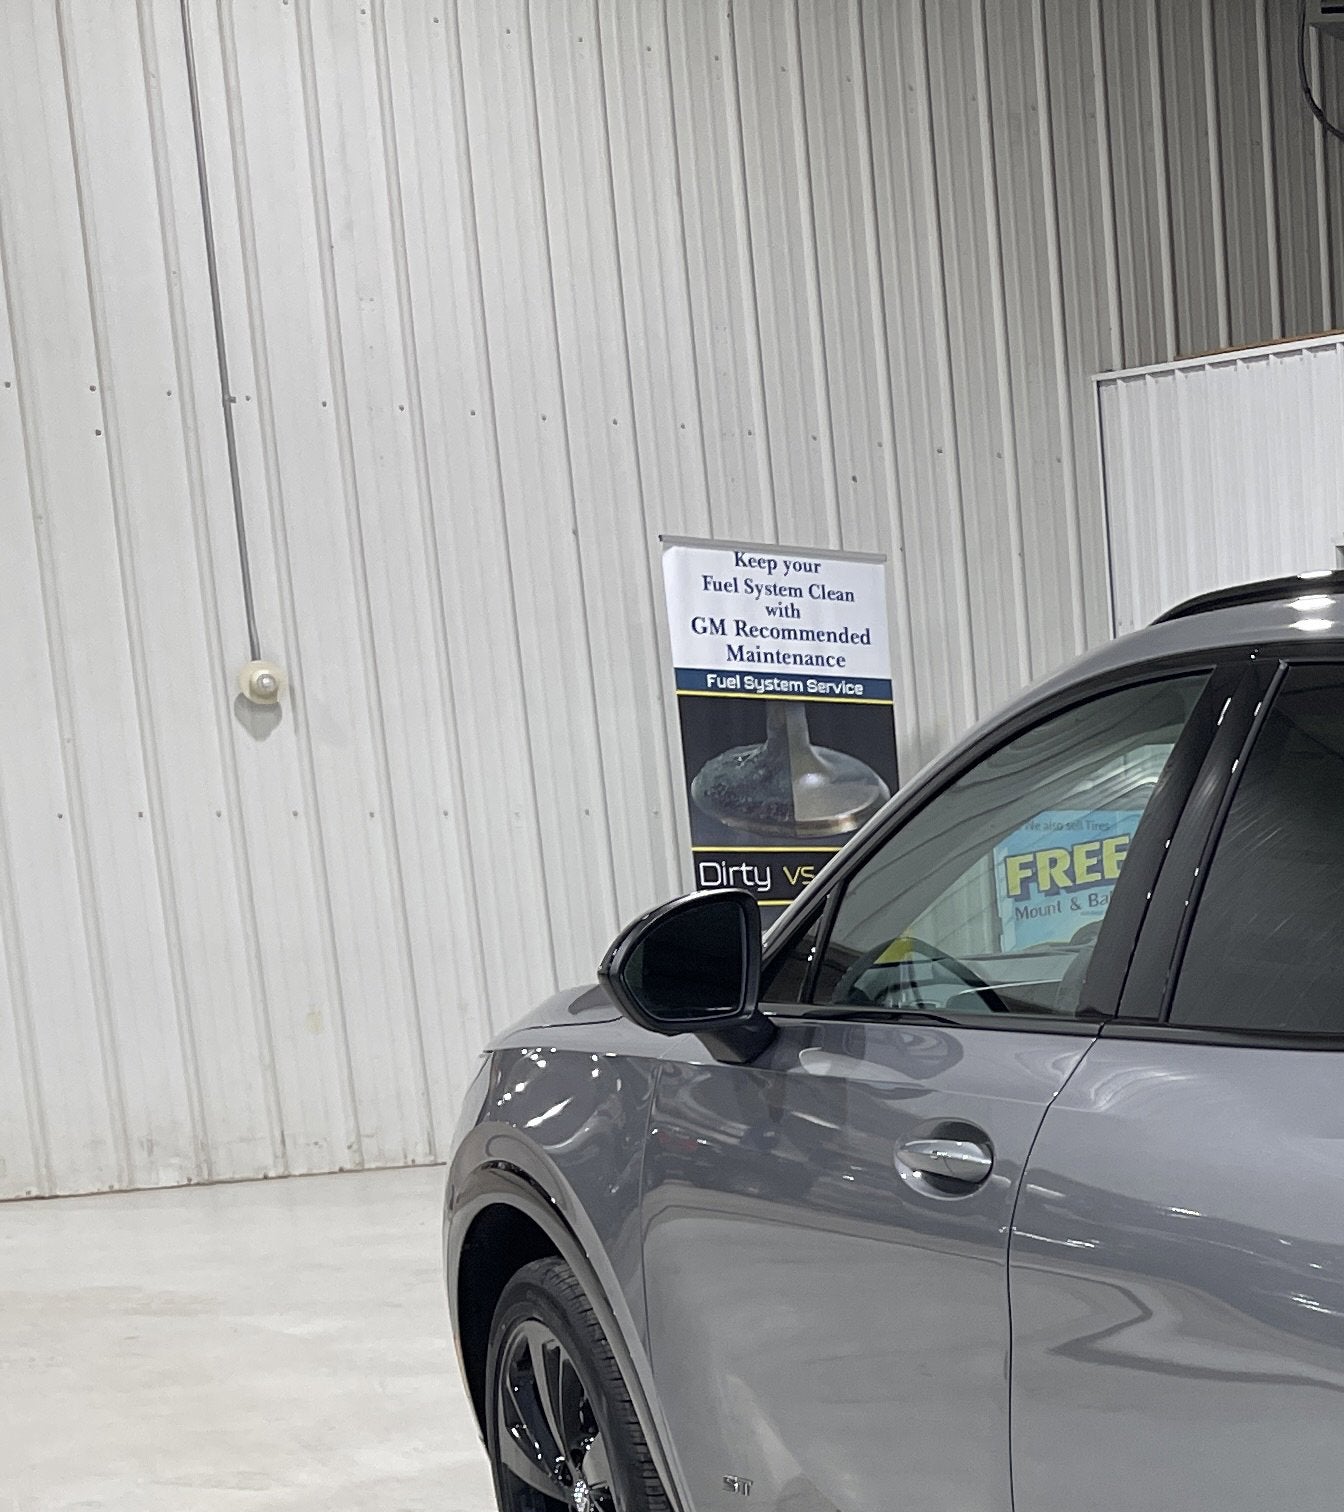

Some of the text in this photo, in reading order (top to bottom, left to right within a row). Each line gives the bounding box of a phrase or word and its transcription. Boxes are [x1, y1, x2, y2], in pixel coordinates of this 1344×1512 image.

[734, 550, 822, 577] Keep your
[702, 574, 855, 603] Fuel System Clean
[765, 602, 801, 619] with
[691, 616, 872, 646] GM Recommended
[726, 644, 847, 669] Maintenance
[706, 673, 864, 696] Fuel System Service
[698, 860, 771, 892] Dirty
[1005, 833, 1131, 898] FREE
[1015, 900, 1062, 921] Mount
[1069, 897, 1081, 911] &
